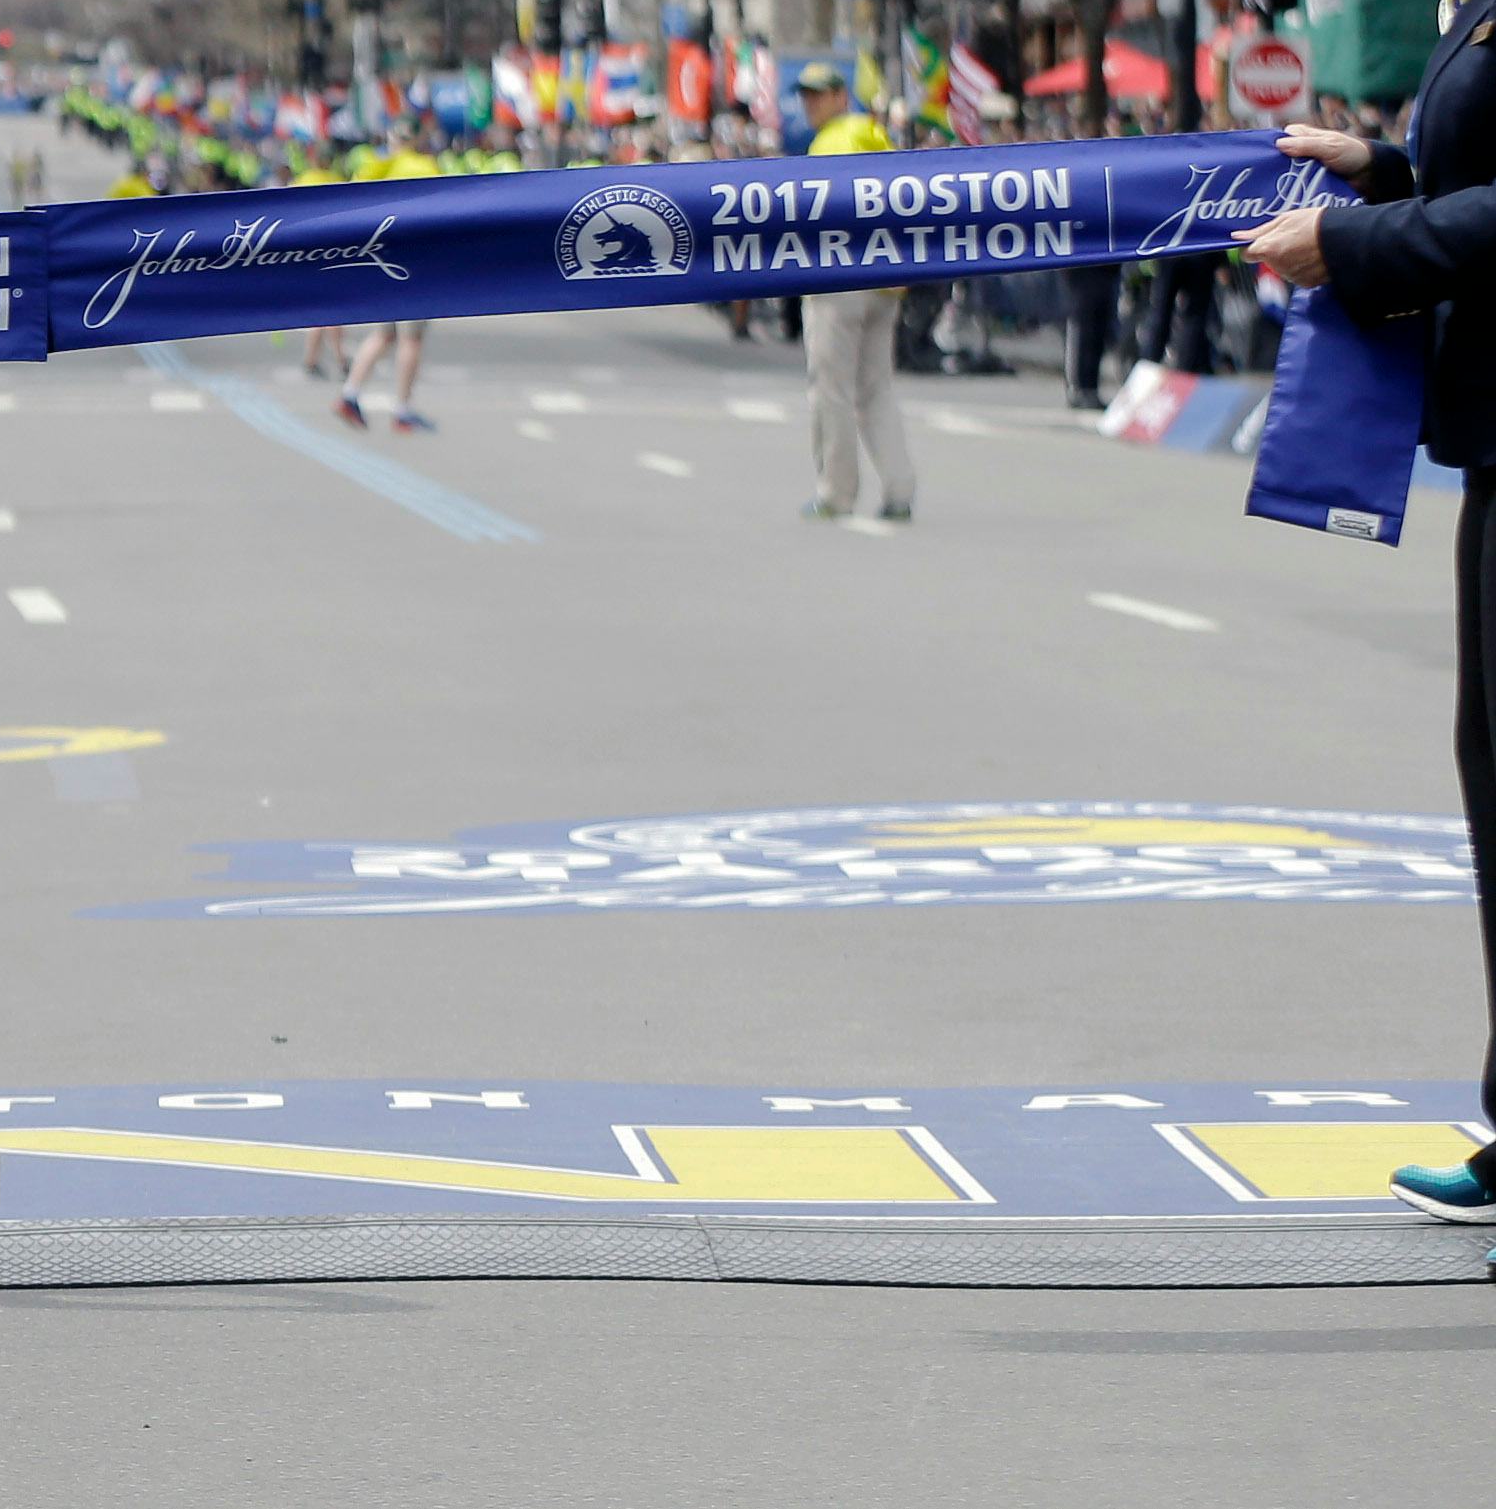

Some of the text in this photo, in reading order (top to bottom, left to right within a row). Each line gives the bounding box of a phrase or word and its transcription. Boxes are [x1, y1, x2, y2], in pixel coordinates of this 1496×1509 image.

[560, 189, 689, 271] BOSTON ATHLETIC ASSOCIATION
[711, 167, 1071, 226] 2017 BOSTON
[1136, 164, 1266, 256] John
[83, 215, 410, 330] John Hancock
[713, 220, 1073, 274] MARATHON
